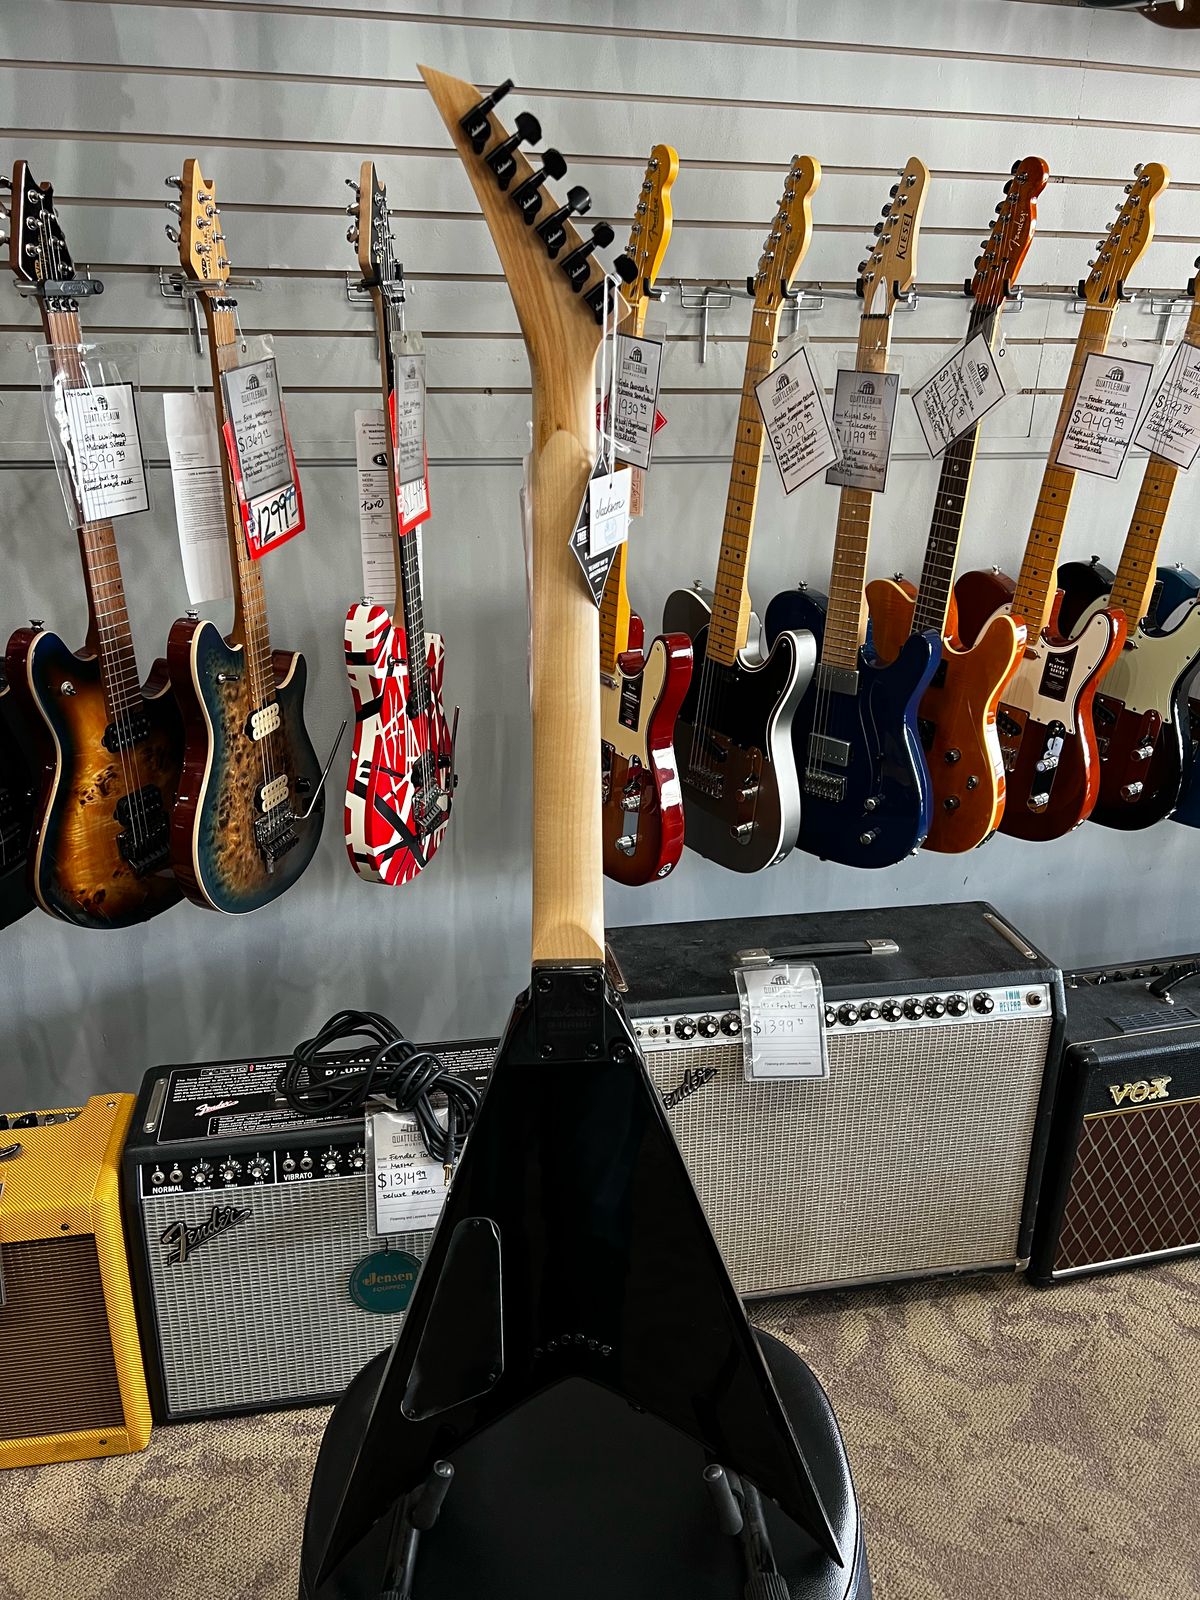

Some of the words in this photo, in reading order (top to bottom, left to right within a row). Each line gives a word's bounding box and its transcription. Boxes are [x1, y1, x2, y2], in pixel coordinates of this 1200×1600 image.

[896, 210, 914, 260] KIESEL
[1009, 211, 1029, 251] Fender
[940, 370, 959, 414] $1149
[1096, 379, 1130, 393] QUATTLEBAUM
[849, 395, 882, 405] QUATTLEBAUM
[1087, 395, 1103, 404] Fender
[1105, 399, 1121, 409] Player
[863, 412, 876, 421] Solo
[1072, 410, 1111, 433] $949
[1114, 417, 1124, 429] 99
[774, 421, 806, 450] $1399
[804, 411, 814, 424] 99
[846, 420, 877, 430] Telecaster
[868, 430, 877, 441] 99
[80, 452, 115, 472] $599
[116, 450, 125, 462] 99
[596, 497, 625, 519] Jackson
[1005, 990, 1021, 1000] TWIN
[753, 1019, 794, 1036] $1399
[662, 1066, 717, 1110] ender
[1110, 1076, 1172, 1106] VOX
[194, 1100, 240, 1117] Fender
[389, 1152, 417, 1161] Fender
[390, 1162, 414, 1170] Master
[283, 1172, 313, 1181] VIBRATO
[377, 1172, 415, 1190] $1314
[416, 1170, 428, 1180] 99
[152, 1185, 183, 1194] NORMAL
[411, 1188, 436, 1196] Reverb
[161, 1206, 252, 1266] Fender
[363, 1272, 413, 1286] Jensen
[373, 1284, 406, 1293] EQUIPPED
